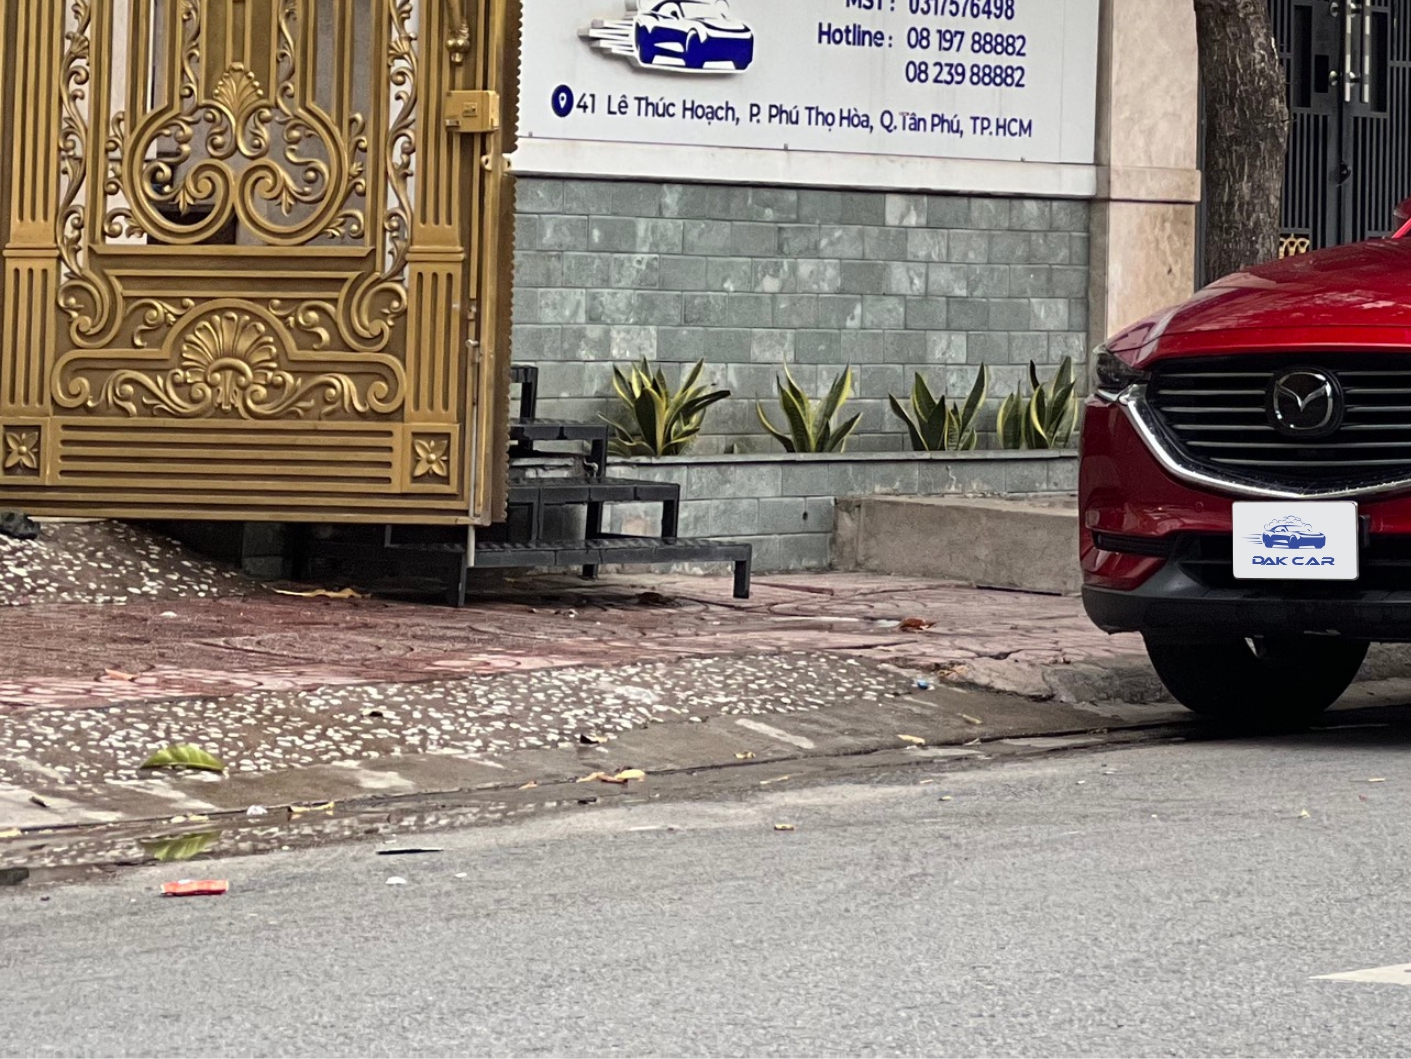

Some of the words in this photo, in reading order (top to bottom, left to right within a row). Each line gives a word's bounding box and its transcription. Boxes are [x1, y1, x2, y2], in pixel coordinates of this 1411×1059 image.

[906, 26, 931, 49] 08
[936, 28, 965, 52] 197
[970, 31, 1027, 57] 88882
[905, 60, 929, 83] 08
[932, 61, 966, 85] 239
[969, 63, 1026, 88] 88882
[576, 93, 596, 114] 41
[606, 94, 629, 116] Lê
[633, 96, 676, 119] Thúc
[681, 99, 740, 126] Hoạch,
[748, 103, 762, 124] P.
[768, 104, 800, 126] Phú
[804, 105, 836, 132] Thọ
[839, 107, 874, 134] Hòa,
[930, 113, 964, 138] Phú,
